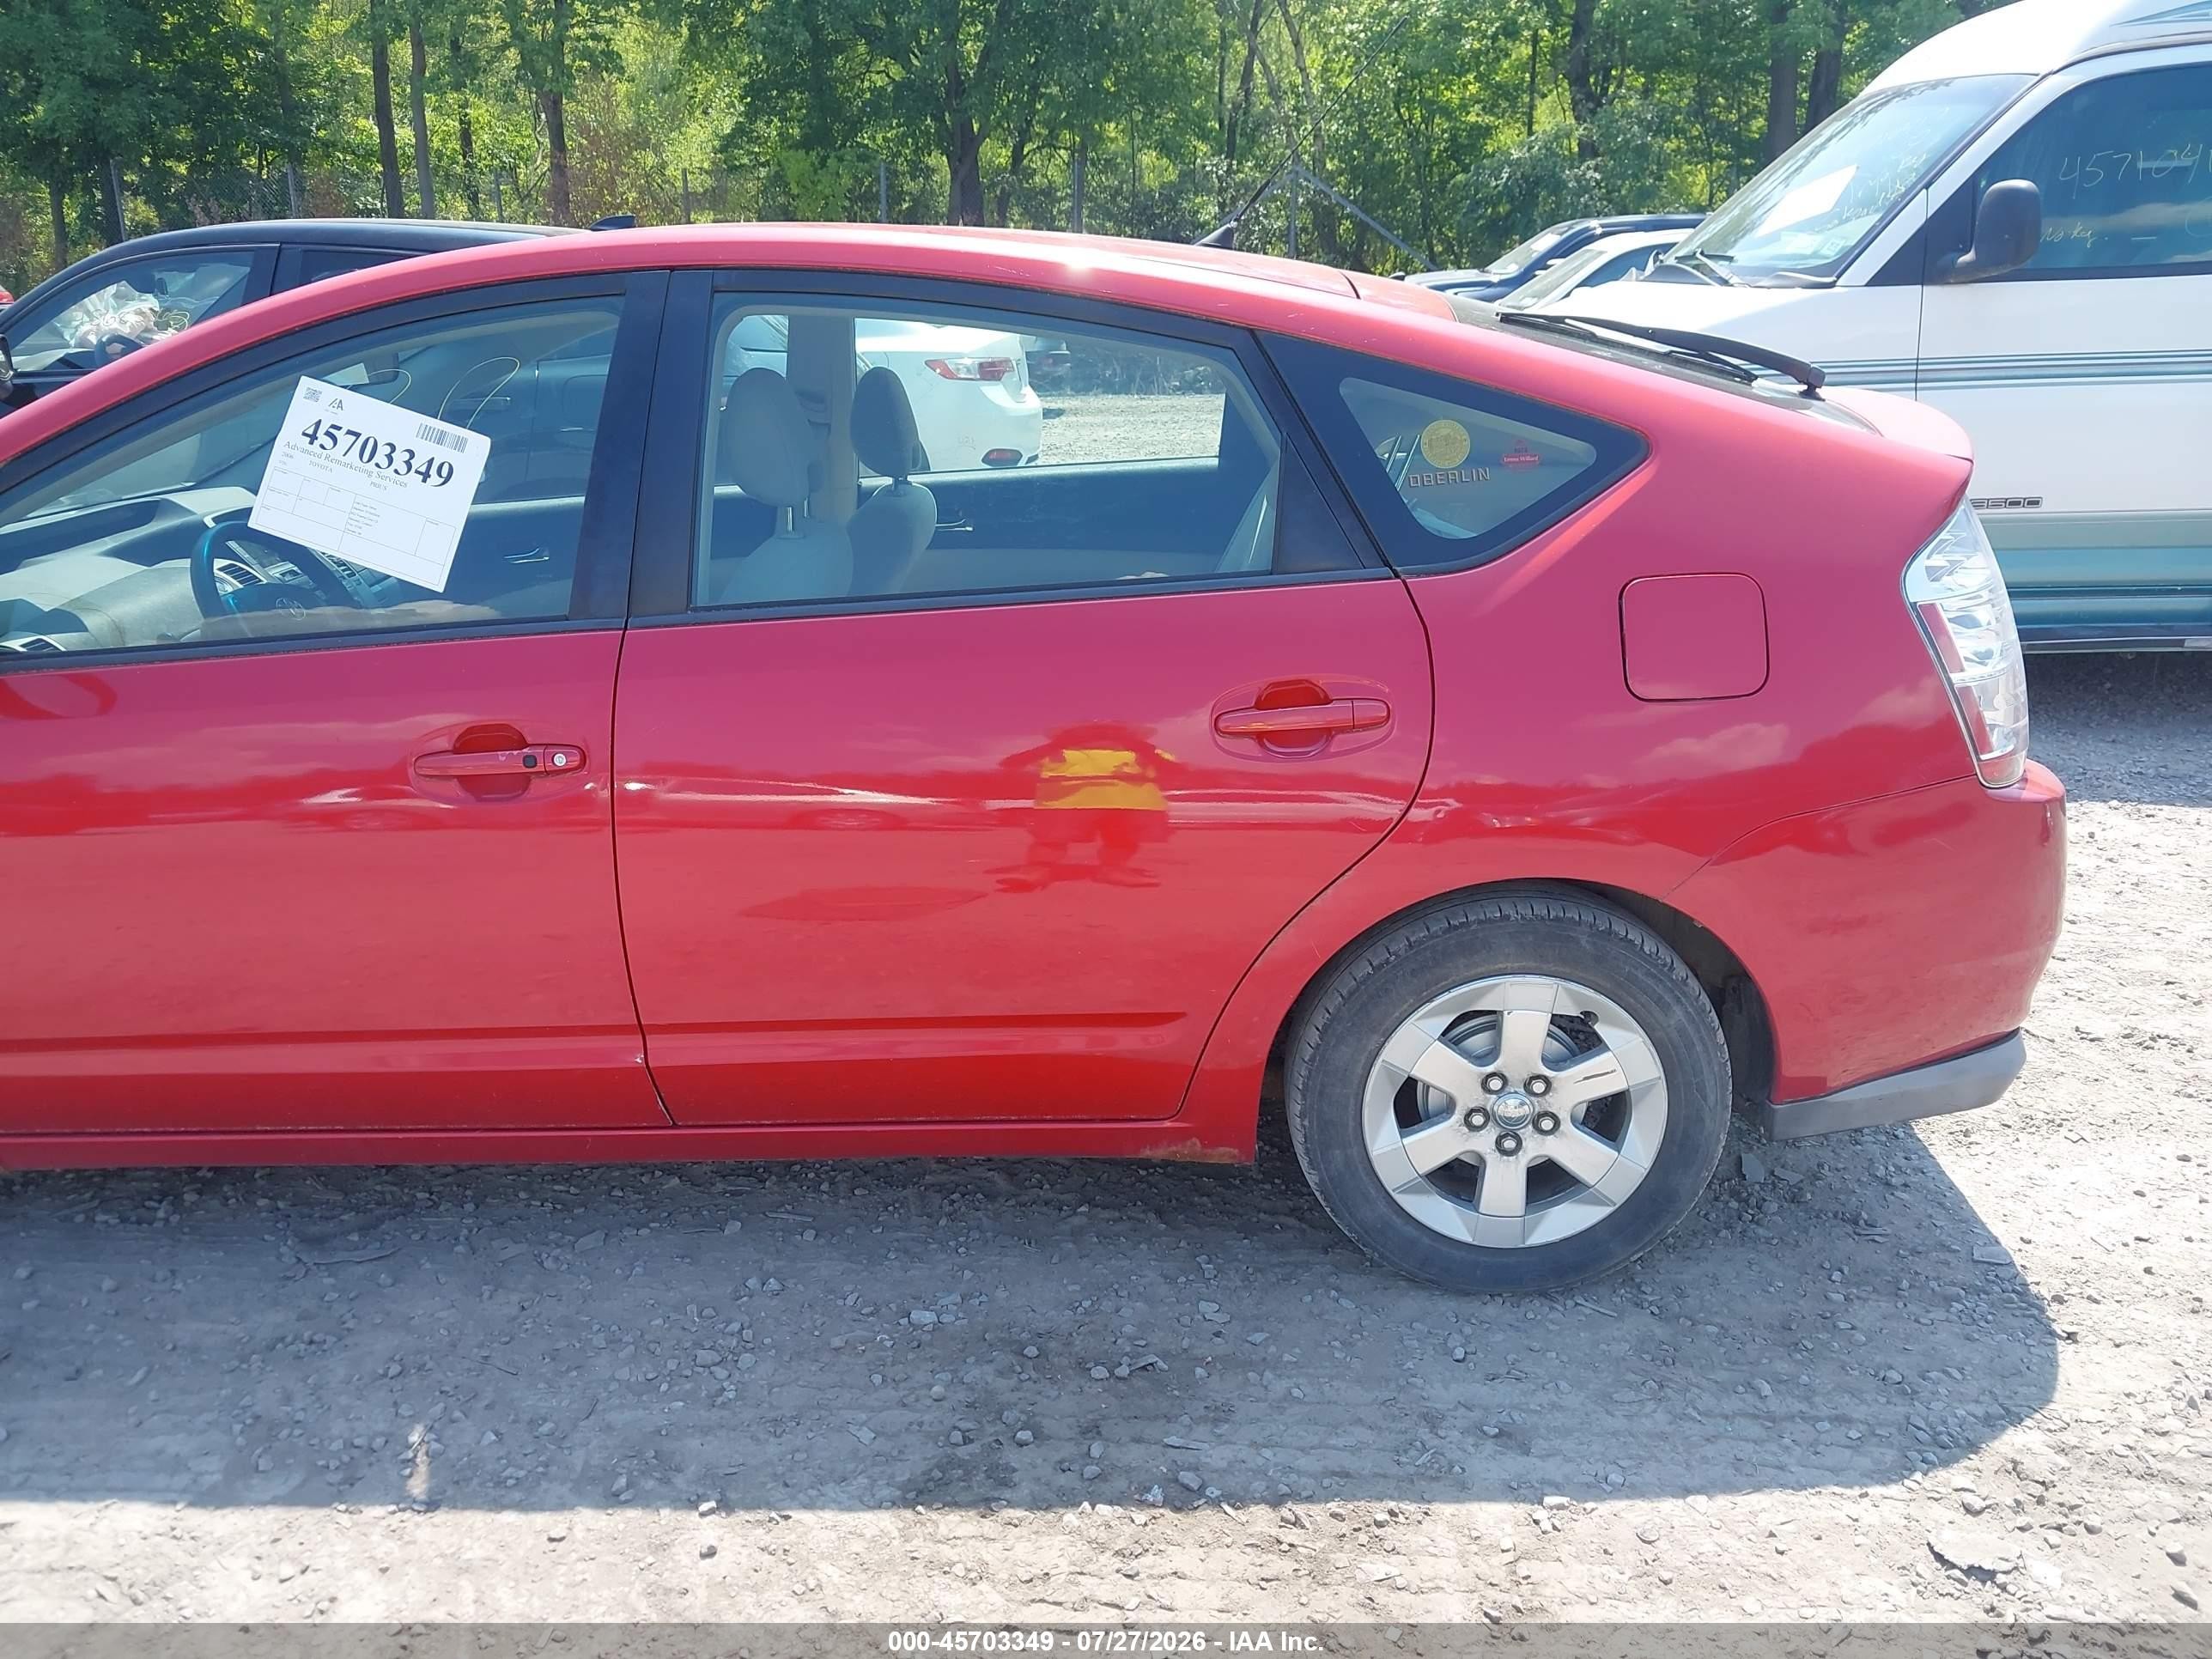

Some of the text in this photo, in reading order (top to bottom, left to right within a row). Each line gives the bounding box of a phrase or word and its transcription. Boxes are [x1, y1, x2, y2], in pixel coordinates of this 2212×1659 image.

[283, 441, 408, 488] Advanced Remarketing Services
[301, 418, 454, 488] 45703349
[308, 460, 333, 473] TOYOTA
[1409, 467, 1490, 487] OBERLIN
